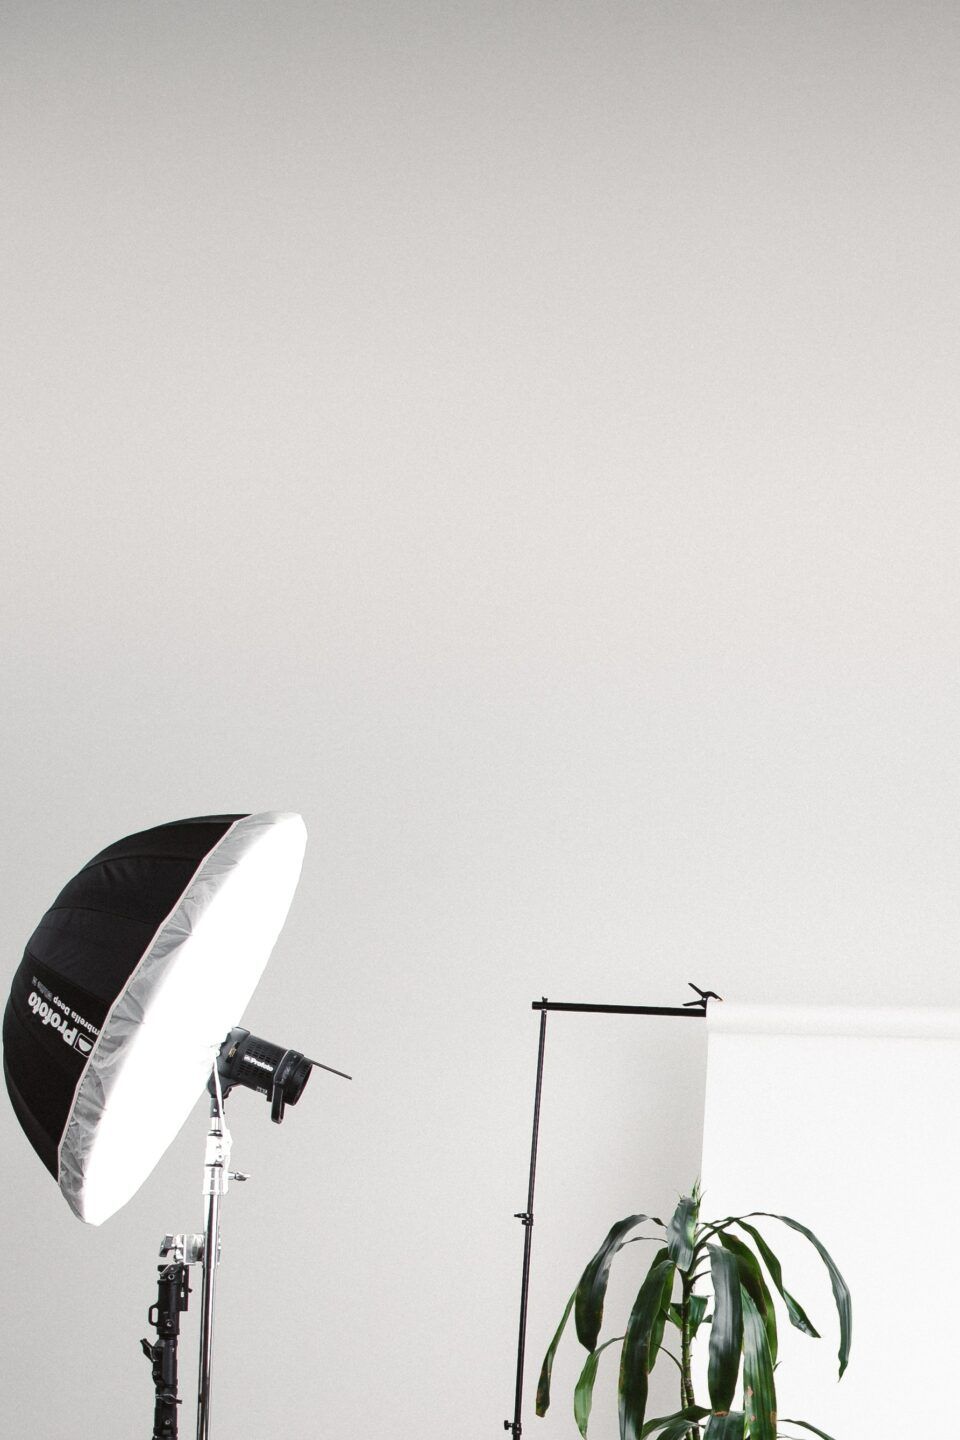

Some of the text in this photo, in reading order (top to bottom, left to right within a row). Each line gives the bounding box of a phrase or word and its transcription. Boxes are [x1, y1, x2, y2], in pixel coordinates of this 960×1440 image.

[27, 992, 78, 1047] Profoto
[53, 996, 100, 1036] mbrella Deep
